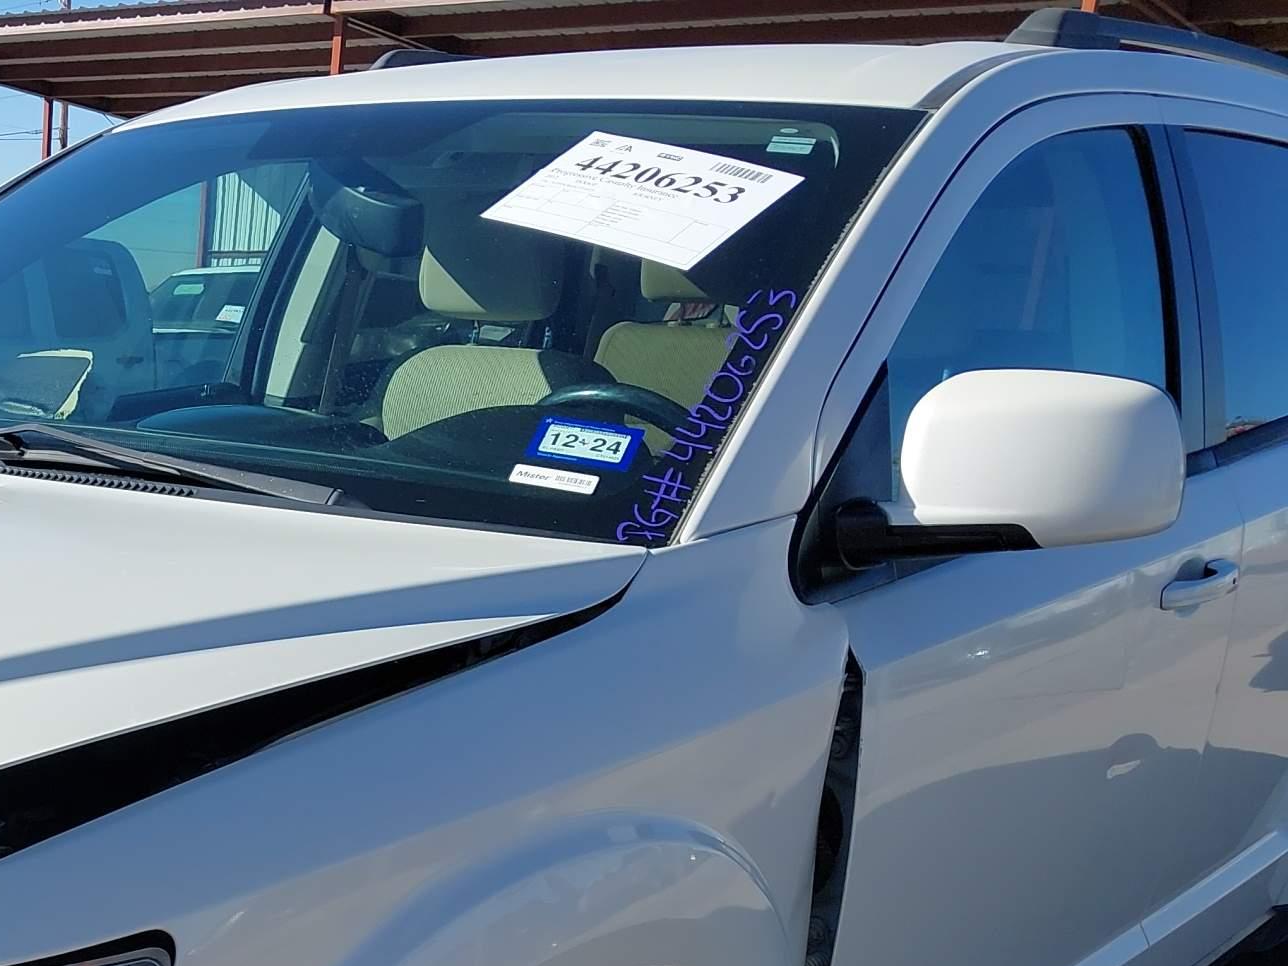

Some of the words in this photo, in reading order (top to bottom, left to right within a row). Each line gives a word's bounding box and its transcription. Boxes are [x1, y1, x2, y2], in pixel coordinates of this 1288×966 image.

[575, 155, 746, 204] 44206253
[550, 432, 580, 449] 12
[589, 437, 623, 455] 24
[516, 470, 551, 481] Mister
